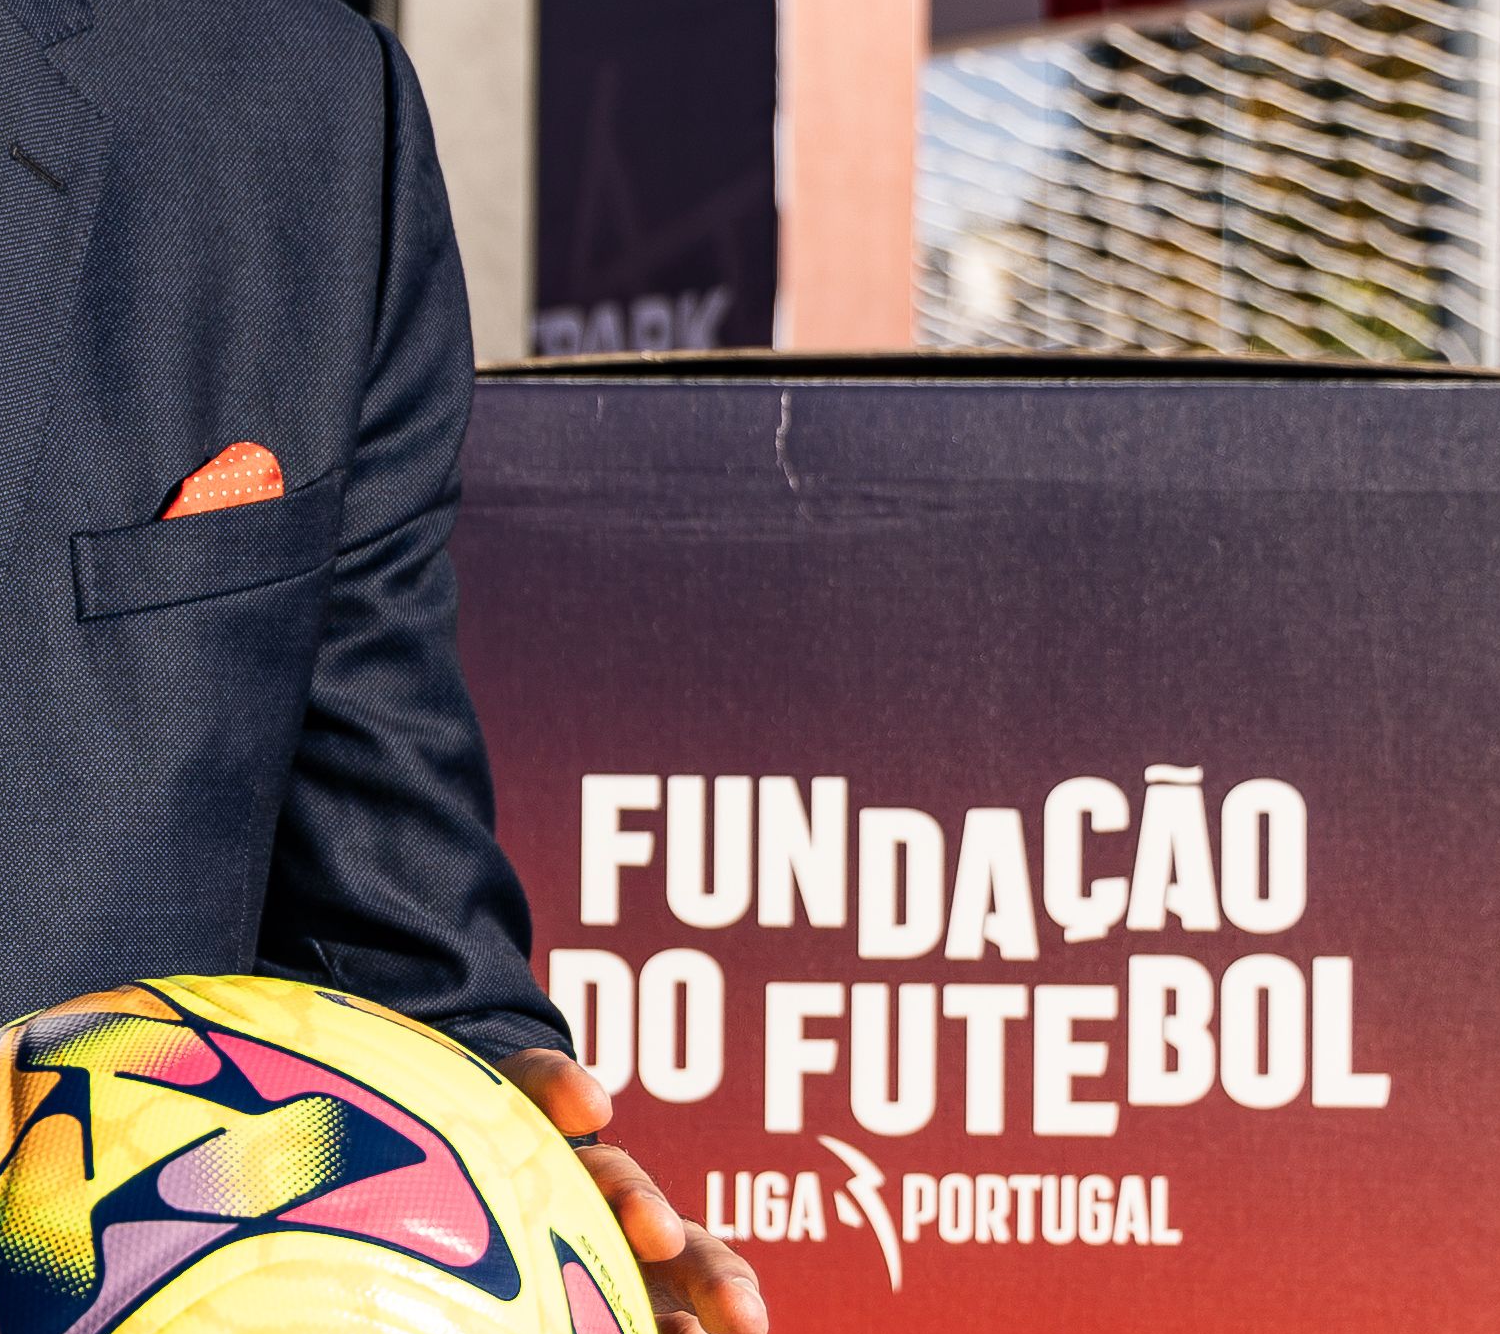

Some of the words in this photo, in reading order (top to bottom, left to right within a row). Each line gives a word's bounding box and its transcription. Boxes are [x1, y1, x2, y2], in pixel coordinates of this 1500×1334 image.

[580, 764, 1307, 961] FUNDAÇÃO
[550, 949, 724, 1103] DO
[764, 954, 1391, 1136] FUTEBOL
[706, 1170, 825, 1242] LIGA
[903, 1174, 1181, 1245] PORTUGAL
